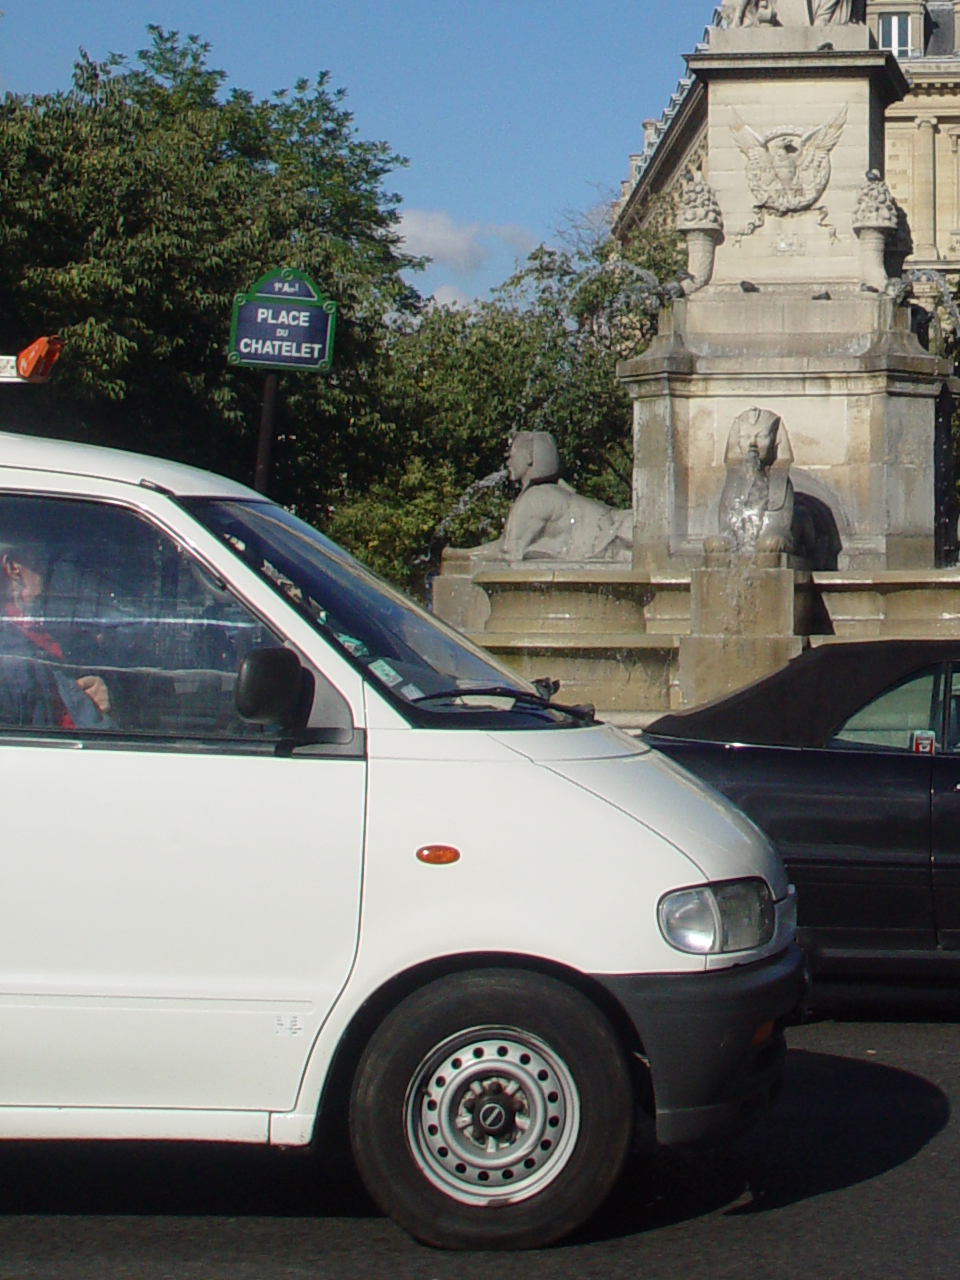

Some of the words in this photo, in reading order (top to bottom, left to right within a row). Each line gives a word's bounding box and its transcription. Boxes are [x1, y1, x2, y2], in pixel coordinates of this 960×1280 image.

[257, 308, 310, 327] PLACE
[276, 328, 289, 337] DU
[240, 338, 323, 359] CHATELET
